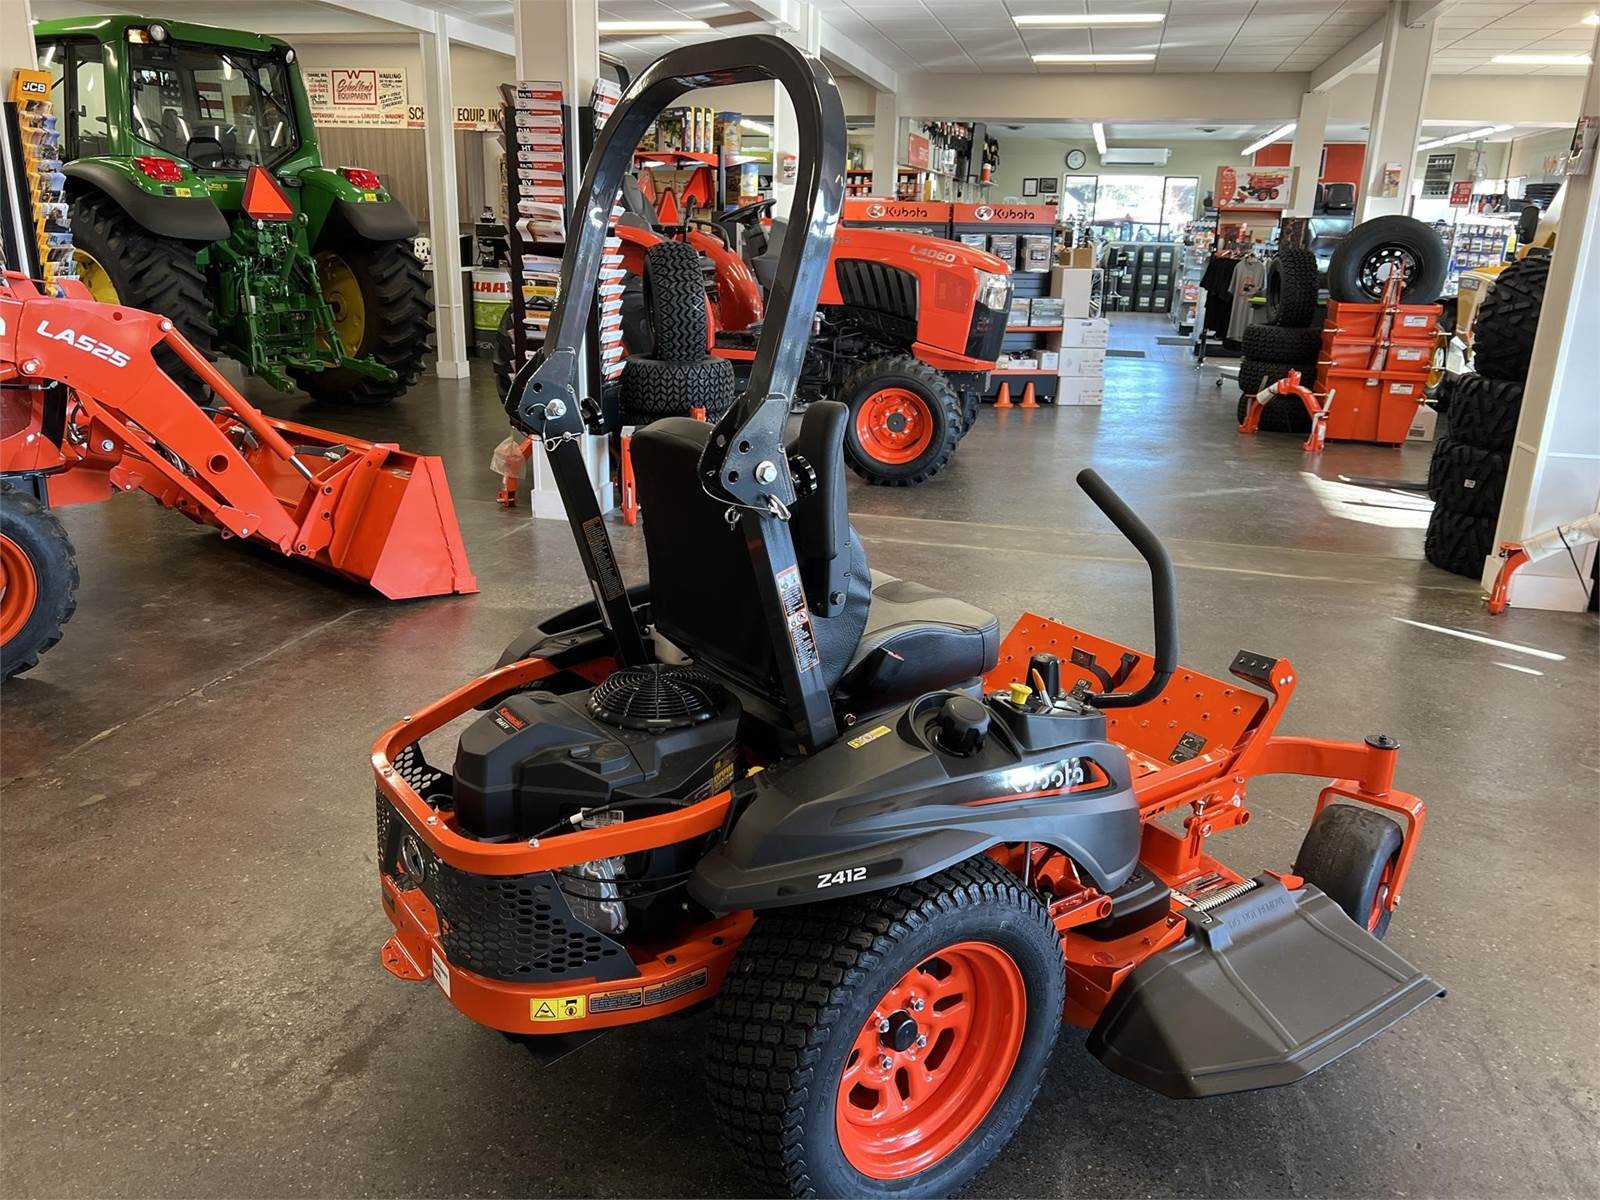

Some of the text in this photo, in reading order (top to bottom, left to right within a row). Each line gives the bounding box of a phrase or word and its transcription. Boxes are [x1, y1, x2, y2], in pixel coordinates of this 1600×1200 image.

[22, 82, 46, 93] JCB
[885, 205, 927, 218] Kubota
[994, 207, 1034, 220] Kubota
[910, 245, 955, 263] L4060
[473, 281, 511, 293] LAA
[36, 320, 131, 368] LA525
[817, 866, 867, 889] Z412
